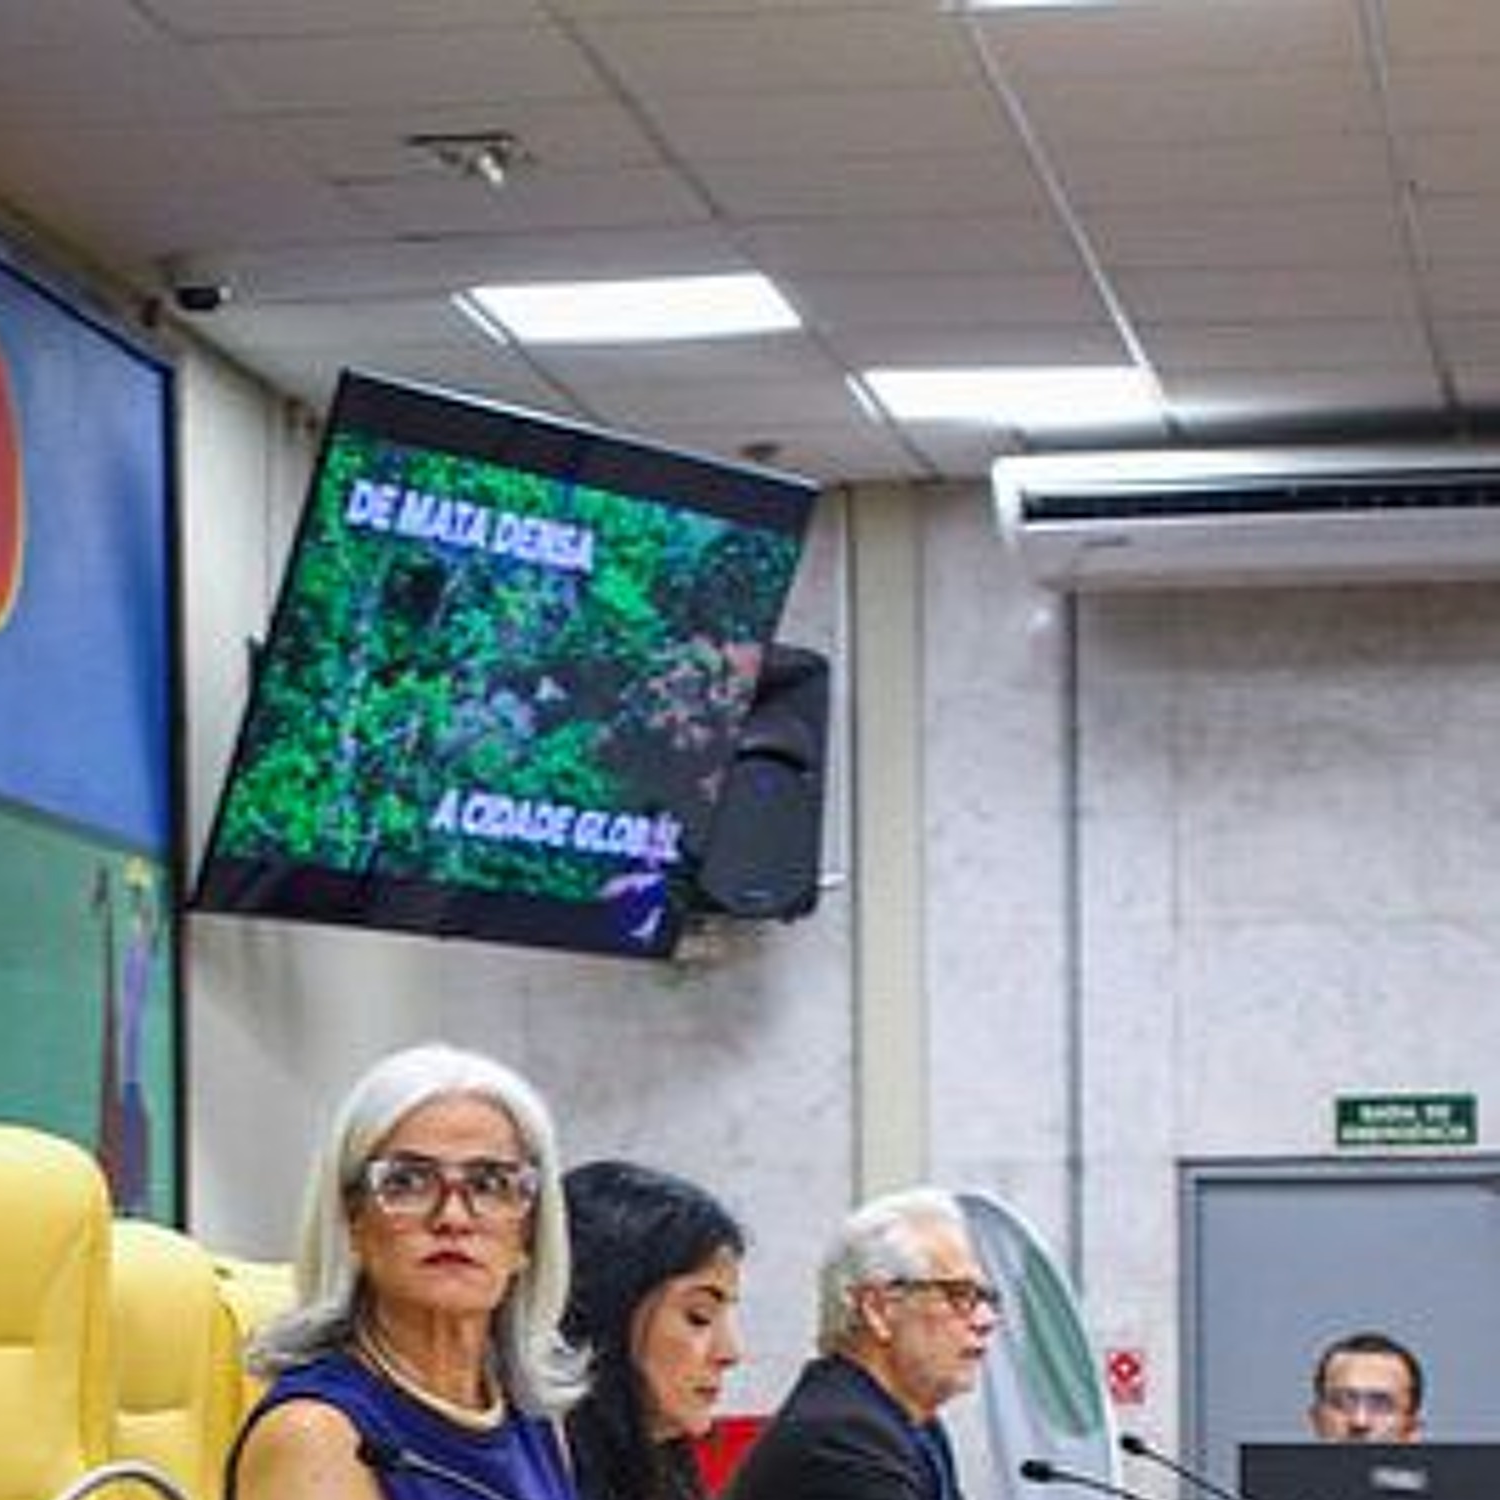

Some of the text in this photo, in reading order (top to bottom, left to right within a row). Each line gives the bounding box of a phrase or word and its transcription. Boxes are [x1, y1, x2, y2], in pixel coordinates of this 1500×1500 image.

[346, 479, 594, 573] DE MATA DENSA
[430, 788, 682, 862] A CIDADE GLOBAL
